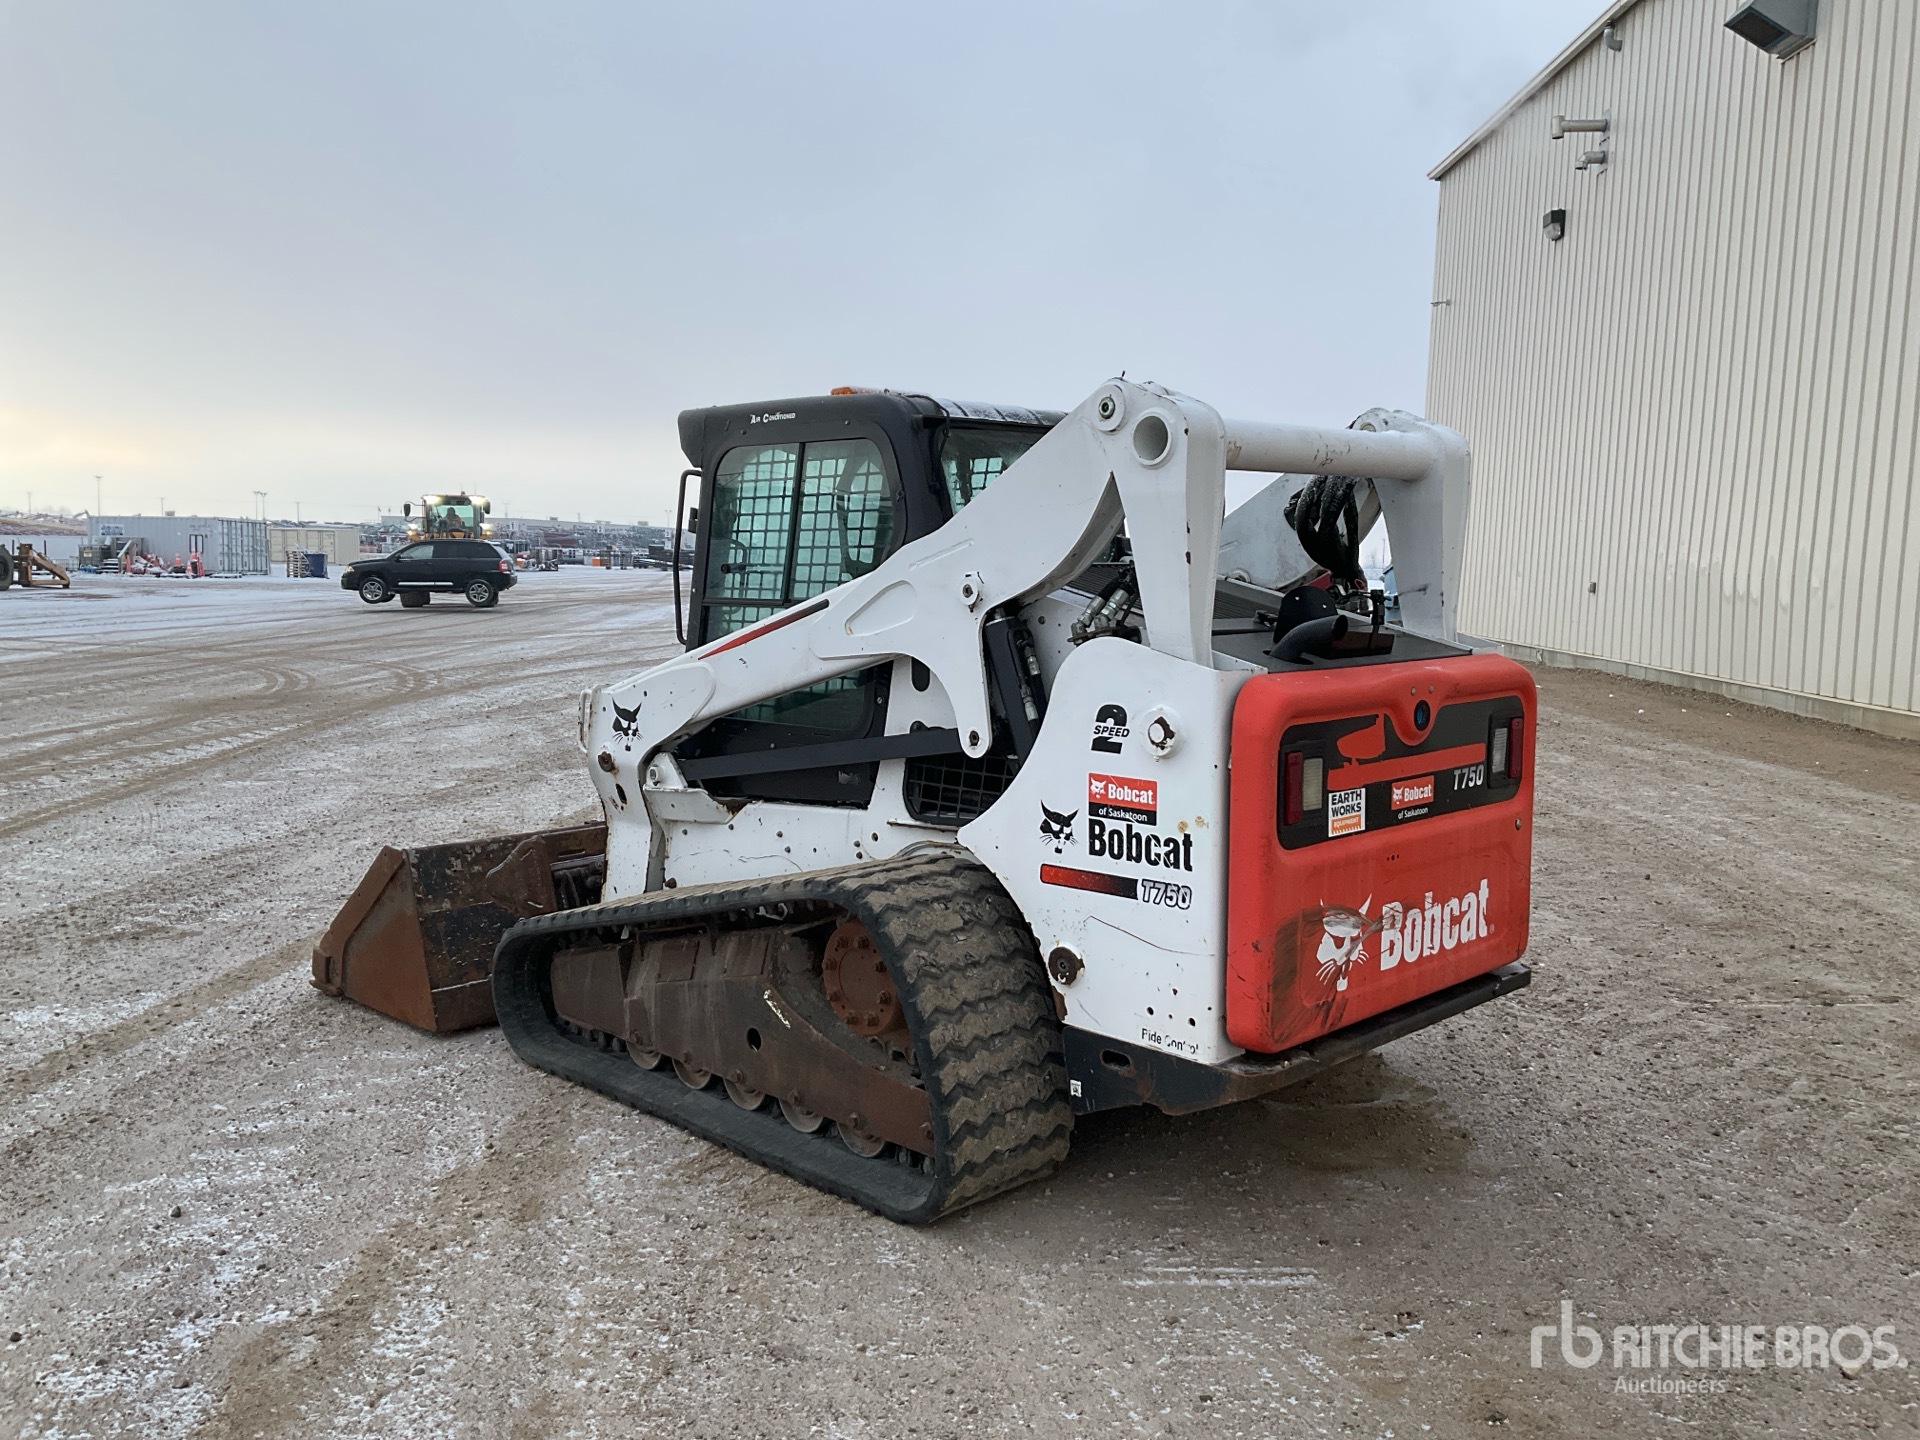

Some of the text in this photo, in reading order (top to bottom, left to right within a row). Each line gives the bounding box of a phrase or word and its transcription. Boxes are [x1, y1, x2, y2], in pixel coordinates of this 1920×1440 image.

[1091, 704, 1128, 754] 2
[1093, 725, 1130, 738] SPEED
[1453, 765, 1484, 790] T750
[1107, 783, 1154, 805] Bobcat
[1331, 790, 1362, 806] EARTH
[1404, 784, 1432, 802] Bobcat
[1098, 807, 1148, 822] of Saskatoon
[1331, 803, 1362, 818] WORKS
[1404, 807, 1428, 818] Saskatoon
[1088, 817, 1193, 872] Bobcat
[1141, 878, 1192, 910] T750
[1380, 878, 1489, 971] Bobcat
